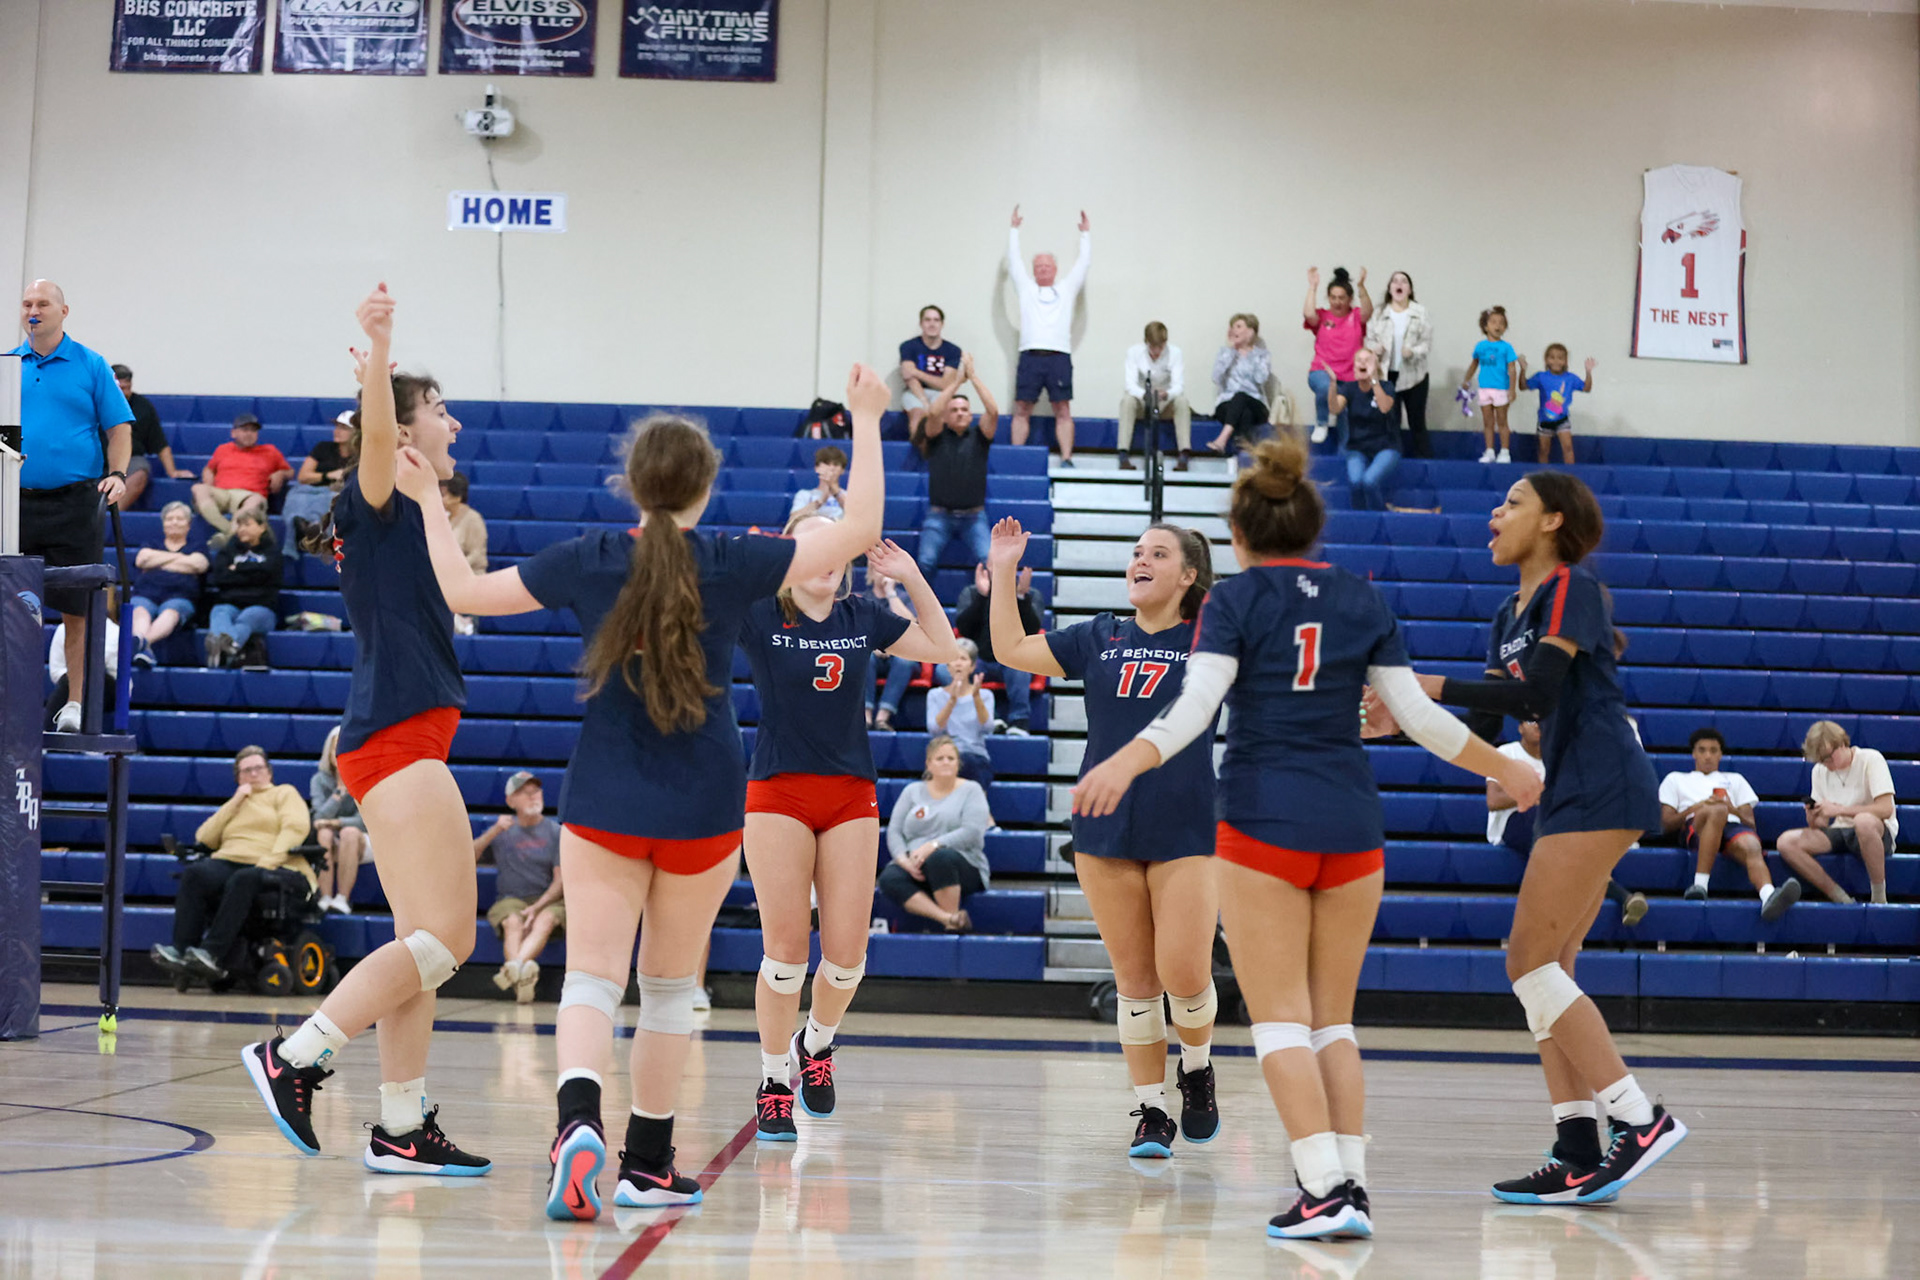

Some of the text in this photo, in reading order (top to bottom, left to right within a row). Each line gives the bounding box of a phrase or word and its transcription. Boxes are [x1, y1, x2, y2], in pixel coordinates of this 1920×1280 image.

[124, 0, 257, 17] BHS CONCRETE
[300, 0, 403, 12] LAMAR
[472, 0, 571, 14] ELVIS'S
[465, 15, 575, 27] AUTOS LLC
[659, 9, 769, 27] ANYTIME
[172, 19, 206, 36] LLC
[661, 26, 769, 42] FITNESS
[128, 37, 144, 46] FOR
[146, 38, 163, 46] ALL
[165, 38, 200, 48] THINGS
[463, 197, 552, 225] HOME
[1680, 252, 1699, 299] 1
[1650, 308, 1729, 327] THE NEST
[772, 634, 867, 650] ST. BENEDICT
[1100, 648, 1189, 662] ST. BENEDIC
[1292, 622, 1323, 691] 1
[812, 653, 845, 692] 3
[1116, 660, 1171, 698] 17
